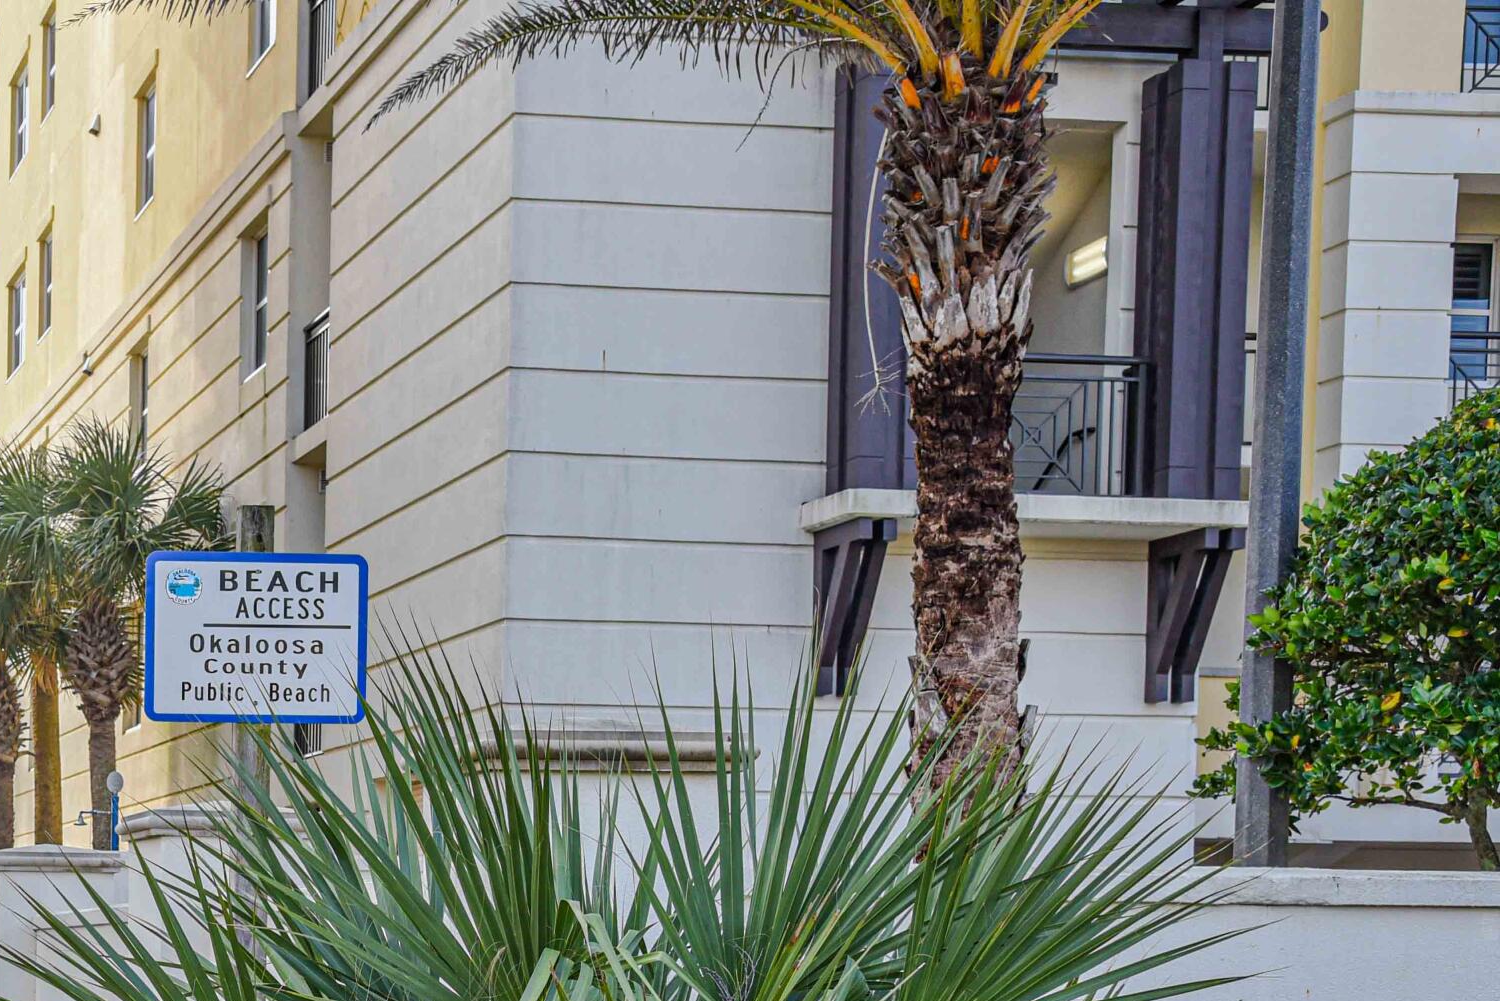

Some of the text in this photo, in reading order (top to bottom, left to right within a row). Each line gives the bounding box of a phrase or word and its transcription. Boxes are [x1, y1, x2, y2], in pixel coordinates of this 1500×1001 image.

[219, 569, 339, 593] BEACH
[235, 596, 325, 620] ACCESS
[189, 633, 324, 655] Okaloosa
[204, 658, 308, 680] County
[181, 681, 331, 703] Public Beach
